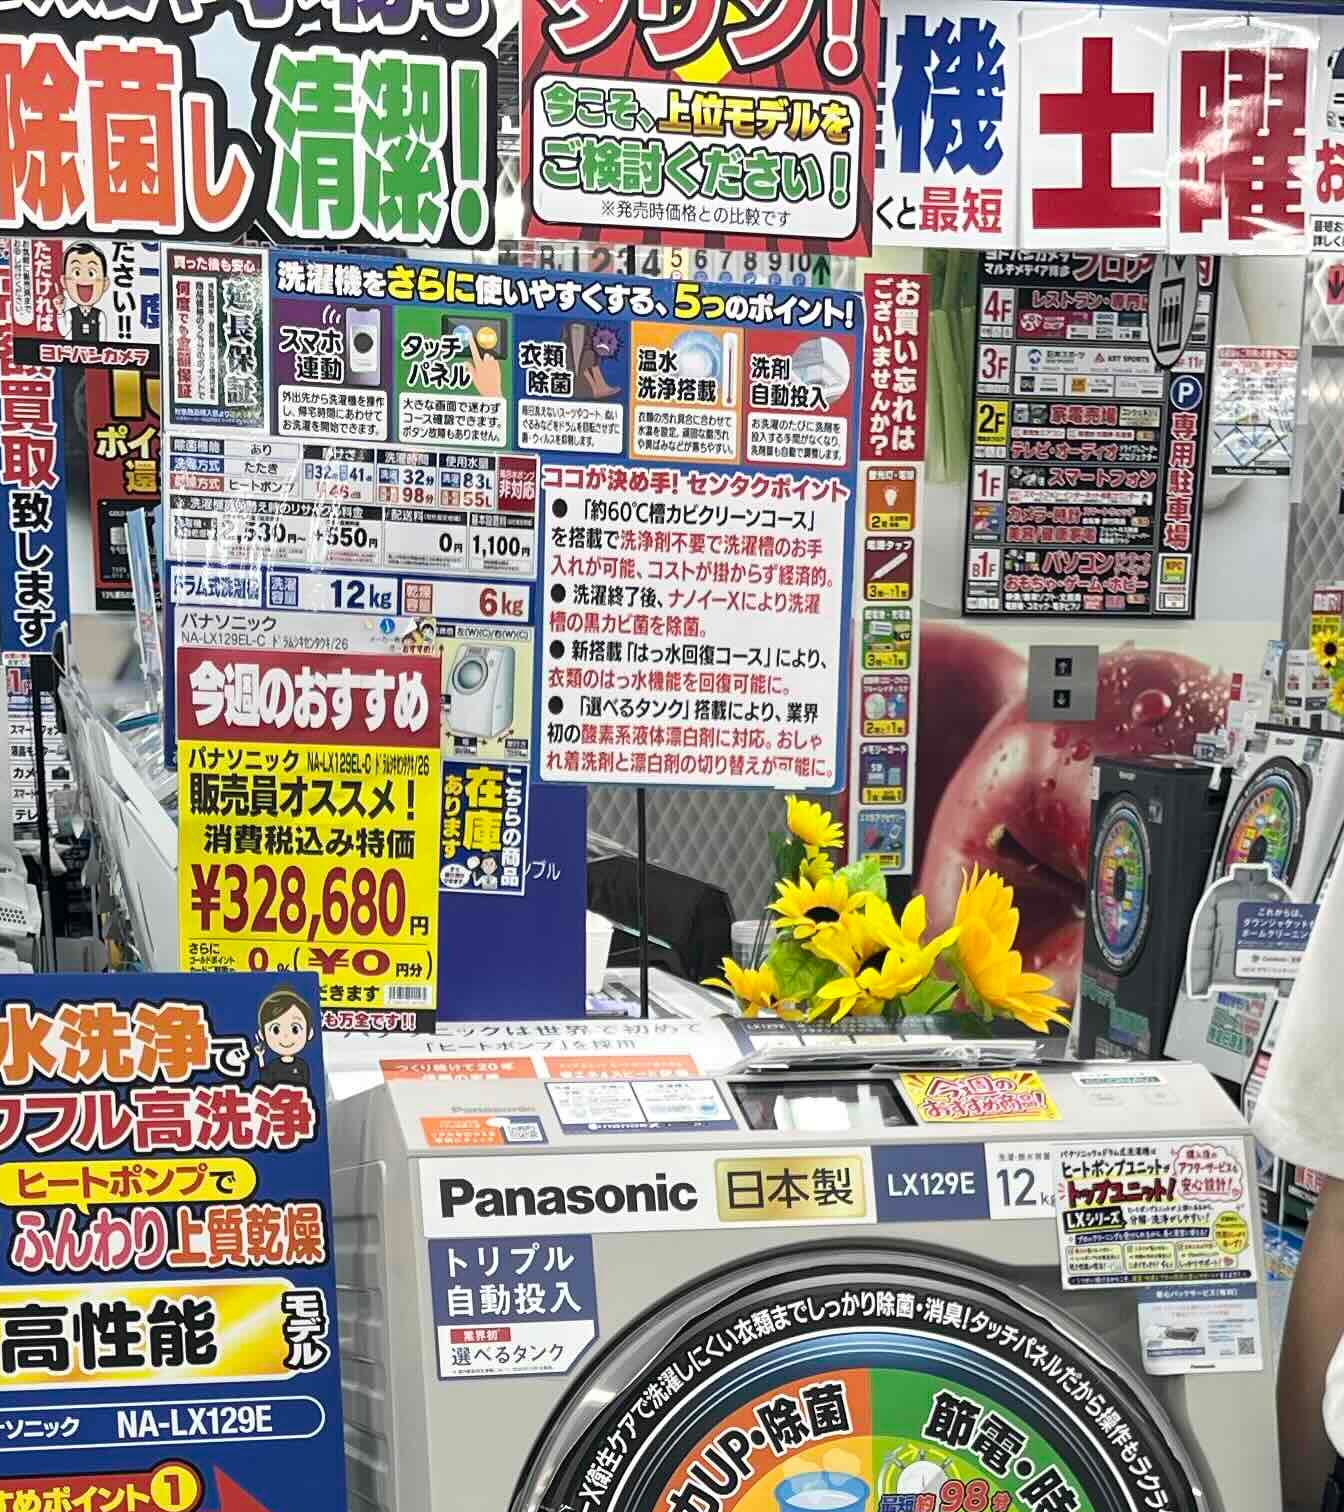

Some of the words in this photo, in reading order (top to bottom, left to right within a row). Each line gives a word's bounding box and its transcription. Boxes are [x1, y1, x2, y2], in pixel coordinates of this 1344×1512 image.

[277, 259, 855, 330] 洗濯機をさらに使いやすくする、5つのポイント!
[984, 291, 1011, 322] 4F
[279, 328, 344, 353] スマホ
[402, 333, 462, 359] タッチ
[40, 344, 150, 366] ヨドバシカメラ
[520, 343, 566, 369] 衣類
[638, 349, 678, 373] 温水
[751, 357, 792, 380] 洗剤
[892, 280, 921, 451] お買い忘れは
[982, 348, 1008, 379] 3F
[408, 364, 471, 388] パネル
[528, 371, 573, 395] 除菌
[637, 378, 717, 403] 洗浄搭載
[751, 385, 829, 409] 自動投入
[402, 399, 501, 414] 大きな画面で迷わず
[1011, 443, 1119, 460] テレビ・オーディオ
[542, 468, 678, 495] ココが決め手!
[687, 474, 848, 501] センタクポイント
[978, 469, 1000, 496] 1F
[1049, 469, 1156, 488] スマートフォン
[1164, 414, 1197, 549] 専用駐車場
[472, 536, 530, 557] 1,100円
[552, 527, 823, 557] を搭載で洗浄剤不要で洗濯槽のお手
[551, 555, 833, 587] 入れが可能、コストが掛からず経済的。
[330, 581, 364, 609] 12
[370, 587, 392, 610] kg
[180, 614, 276, 632] パナソニック
[548, 668, 790, 695] 衣類のはっ水機能を回復可能に。
[188, 662, 428, 732] 今週のおすすめ
[188, 750, 299, 772] パナソニック
[307, 755, 371, 774] NA-LX129EL-C
[465, 765, 504, 853] 在庫
[203, 825, 415, 859] 消費税込み特価
[191, 864, 407, 942] ¥328,680
[928, 1074, 1017, 1097] 今週の
[17, 1163, 236, 1199] ヒートポンプで
[439, 1172, 698, 1218] Panasonic
[726, 1168, 853, 1210] 日本製
[887, 1172, 976, 1197] LX129E
[996, 1168, 1037, 1208] 12
[1066, 1213, 1120, 1228] LXシリーズ
[13, 1205, 324, 1270] ふんわり上質乾燥
[446, 1246, 575, 1278] トリプル
[447, 1283, 582, 1316] 自動投入
[451, 1343, 565, 1367] 選べるタンク
[117, 1405, 273, 1438] NA-LX129E
